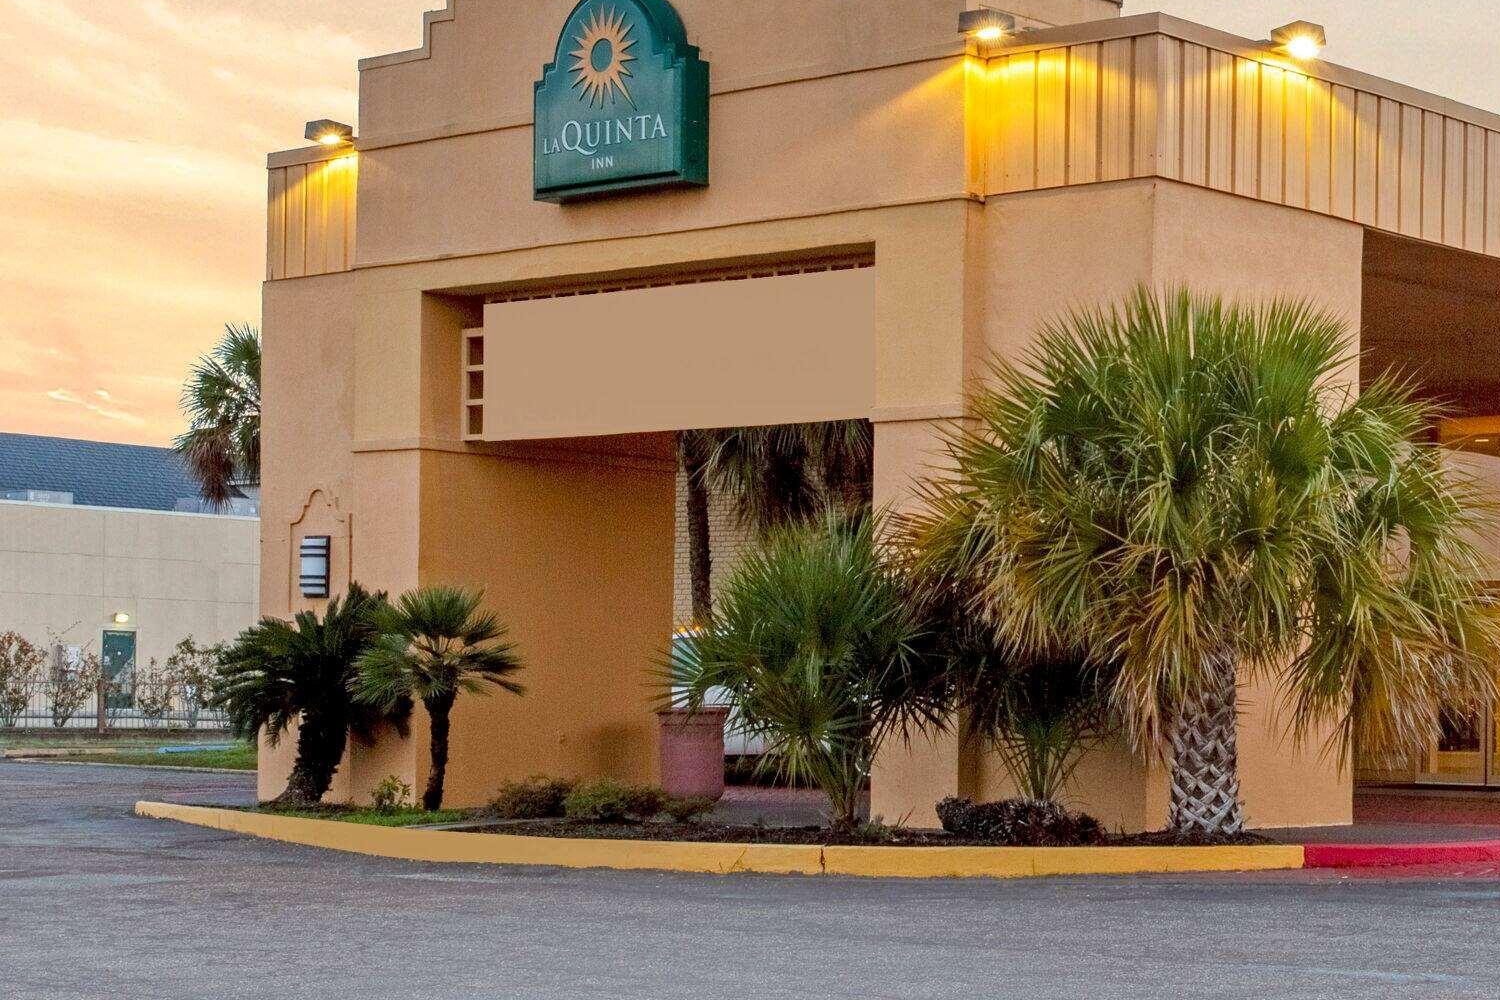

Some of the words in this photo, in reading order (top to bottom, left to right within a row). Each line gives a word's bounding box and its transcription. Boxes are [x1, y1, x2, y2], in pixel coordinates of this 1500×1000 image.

[543, 136, 561, 155] LA
[561, 113, 668, 155] QUINTA
[591, 155, 614, 169] INN
